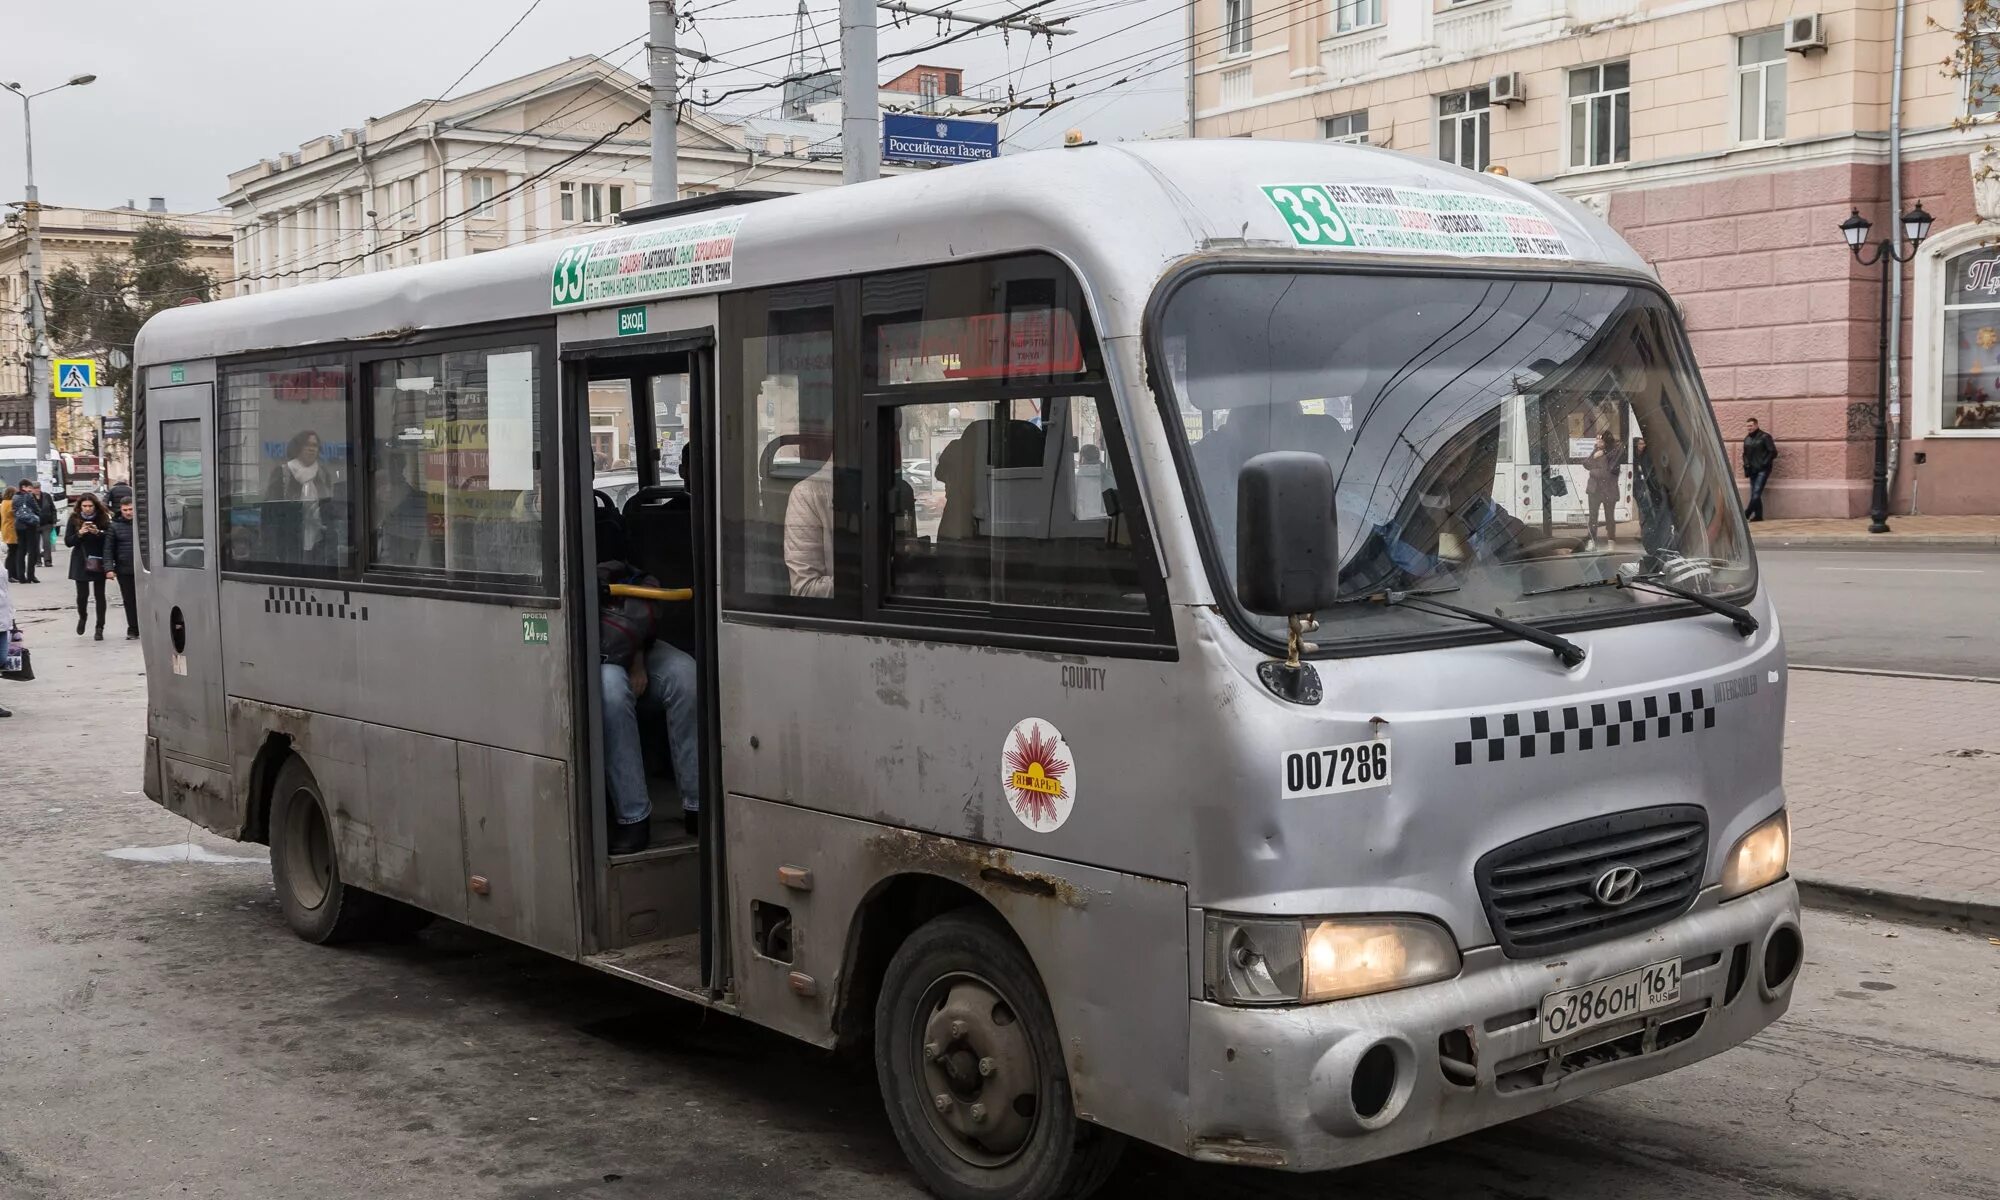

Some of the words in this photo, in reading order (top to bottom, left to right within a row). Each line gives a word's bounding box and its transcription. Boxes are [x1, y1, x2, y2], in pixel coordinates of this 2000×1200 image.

[889, 138, 956, 156] Российская
[958, 143, 993, 159] Газета
[1325, 185, 1358, 203] ВЕРХ.
[1350, 186, 1401, 206] ТЕМЕРНИК
[1273, 186, 1347, 243] 33
[1512, 236, 1537, 254] ВЕРХ.
[1531, 237, 1570, 256] ТЕМЕРНИК
[554, 245, 590, 302] 33
[690, 264, 704, 285] ВЕРХ.
[705, 260, 730, 283] ТЕМЕРНИК
[621, 311, 644, 331] ВХОД
[523, 621, 536, 641] 24
[535, 632, 548, 640] РУБ
[1061, 665, 1106, 691] COUNTY
[1286, 742, 1387, 792] 007286
[1642, 962, 1678, 996] 161
[1649, 991, 1668, 1005] RUS
